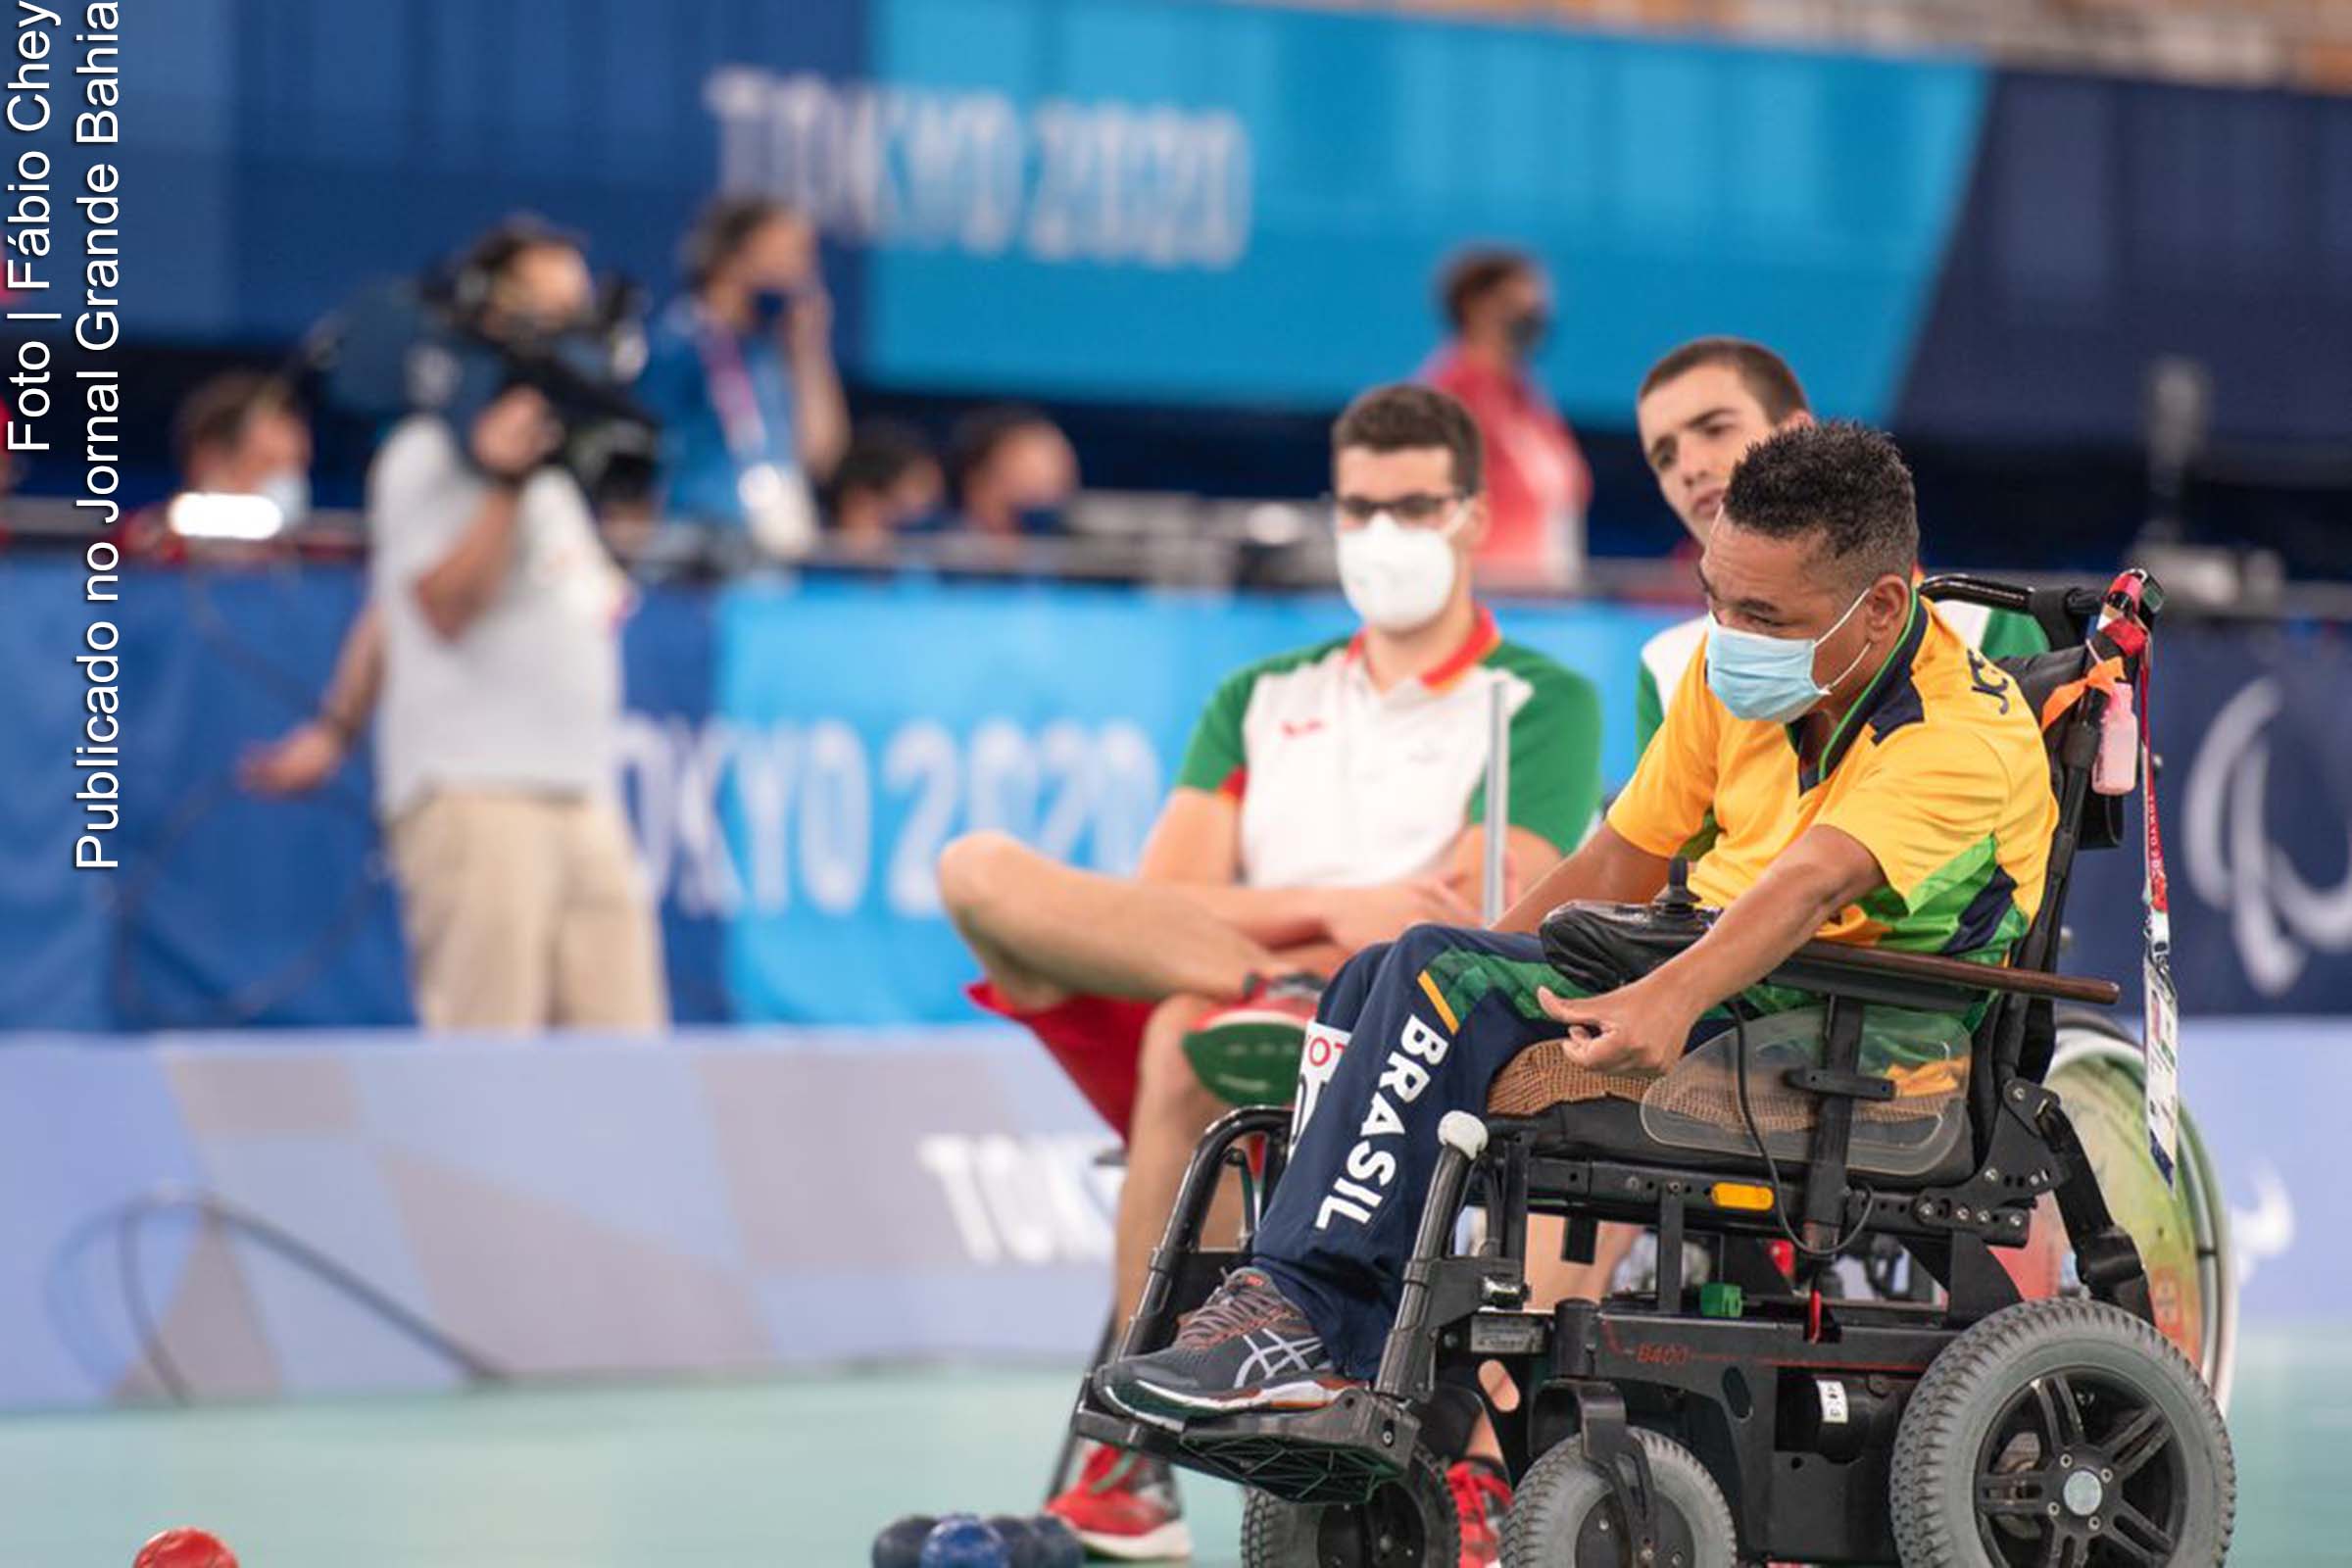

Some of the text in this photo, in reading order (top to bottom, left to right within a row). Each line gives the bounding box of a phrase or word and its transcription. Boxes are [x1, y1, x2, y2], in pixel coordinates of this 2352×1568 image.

[706, 69, 1020, 255] TOKYO
[617, 713, 871, 916] OKYO
[1315, 1014, 1448, 1229] BRASIL
